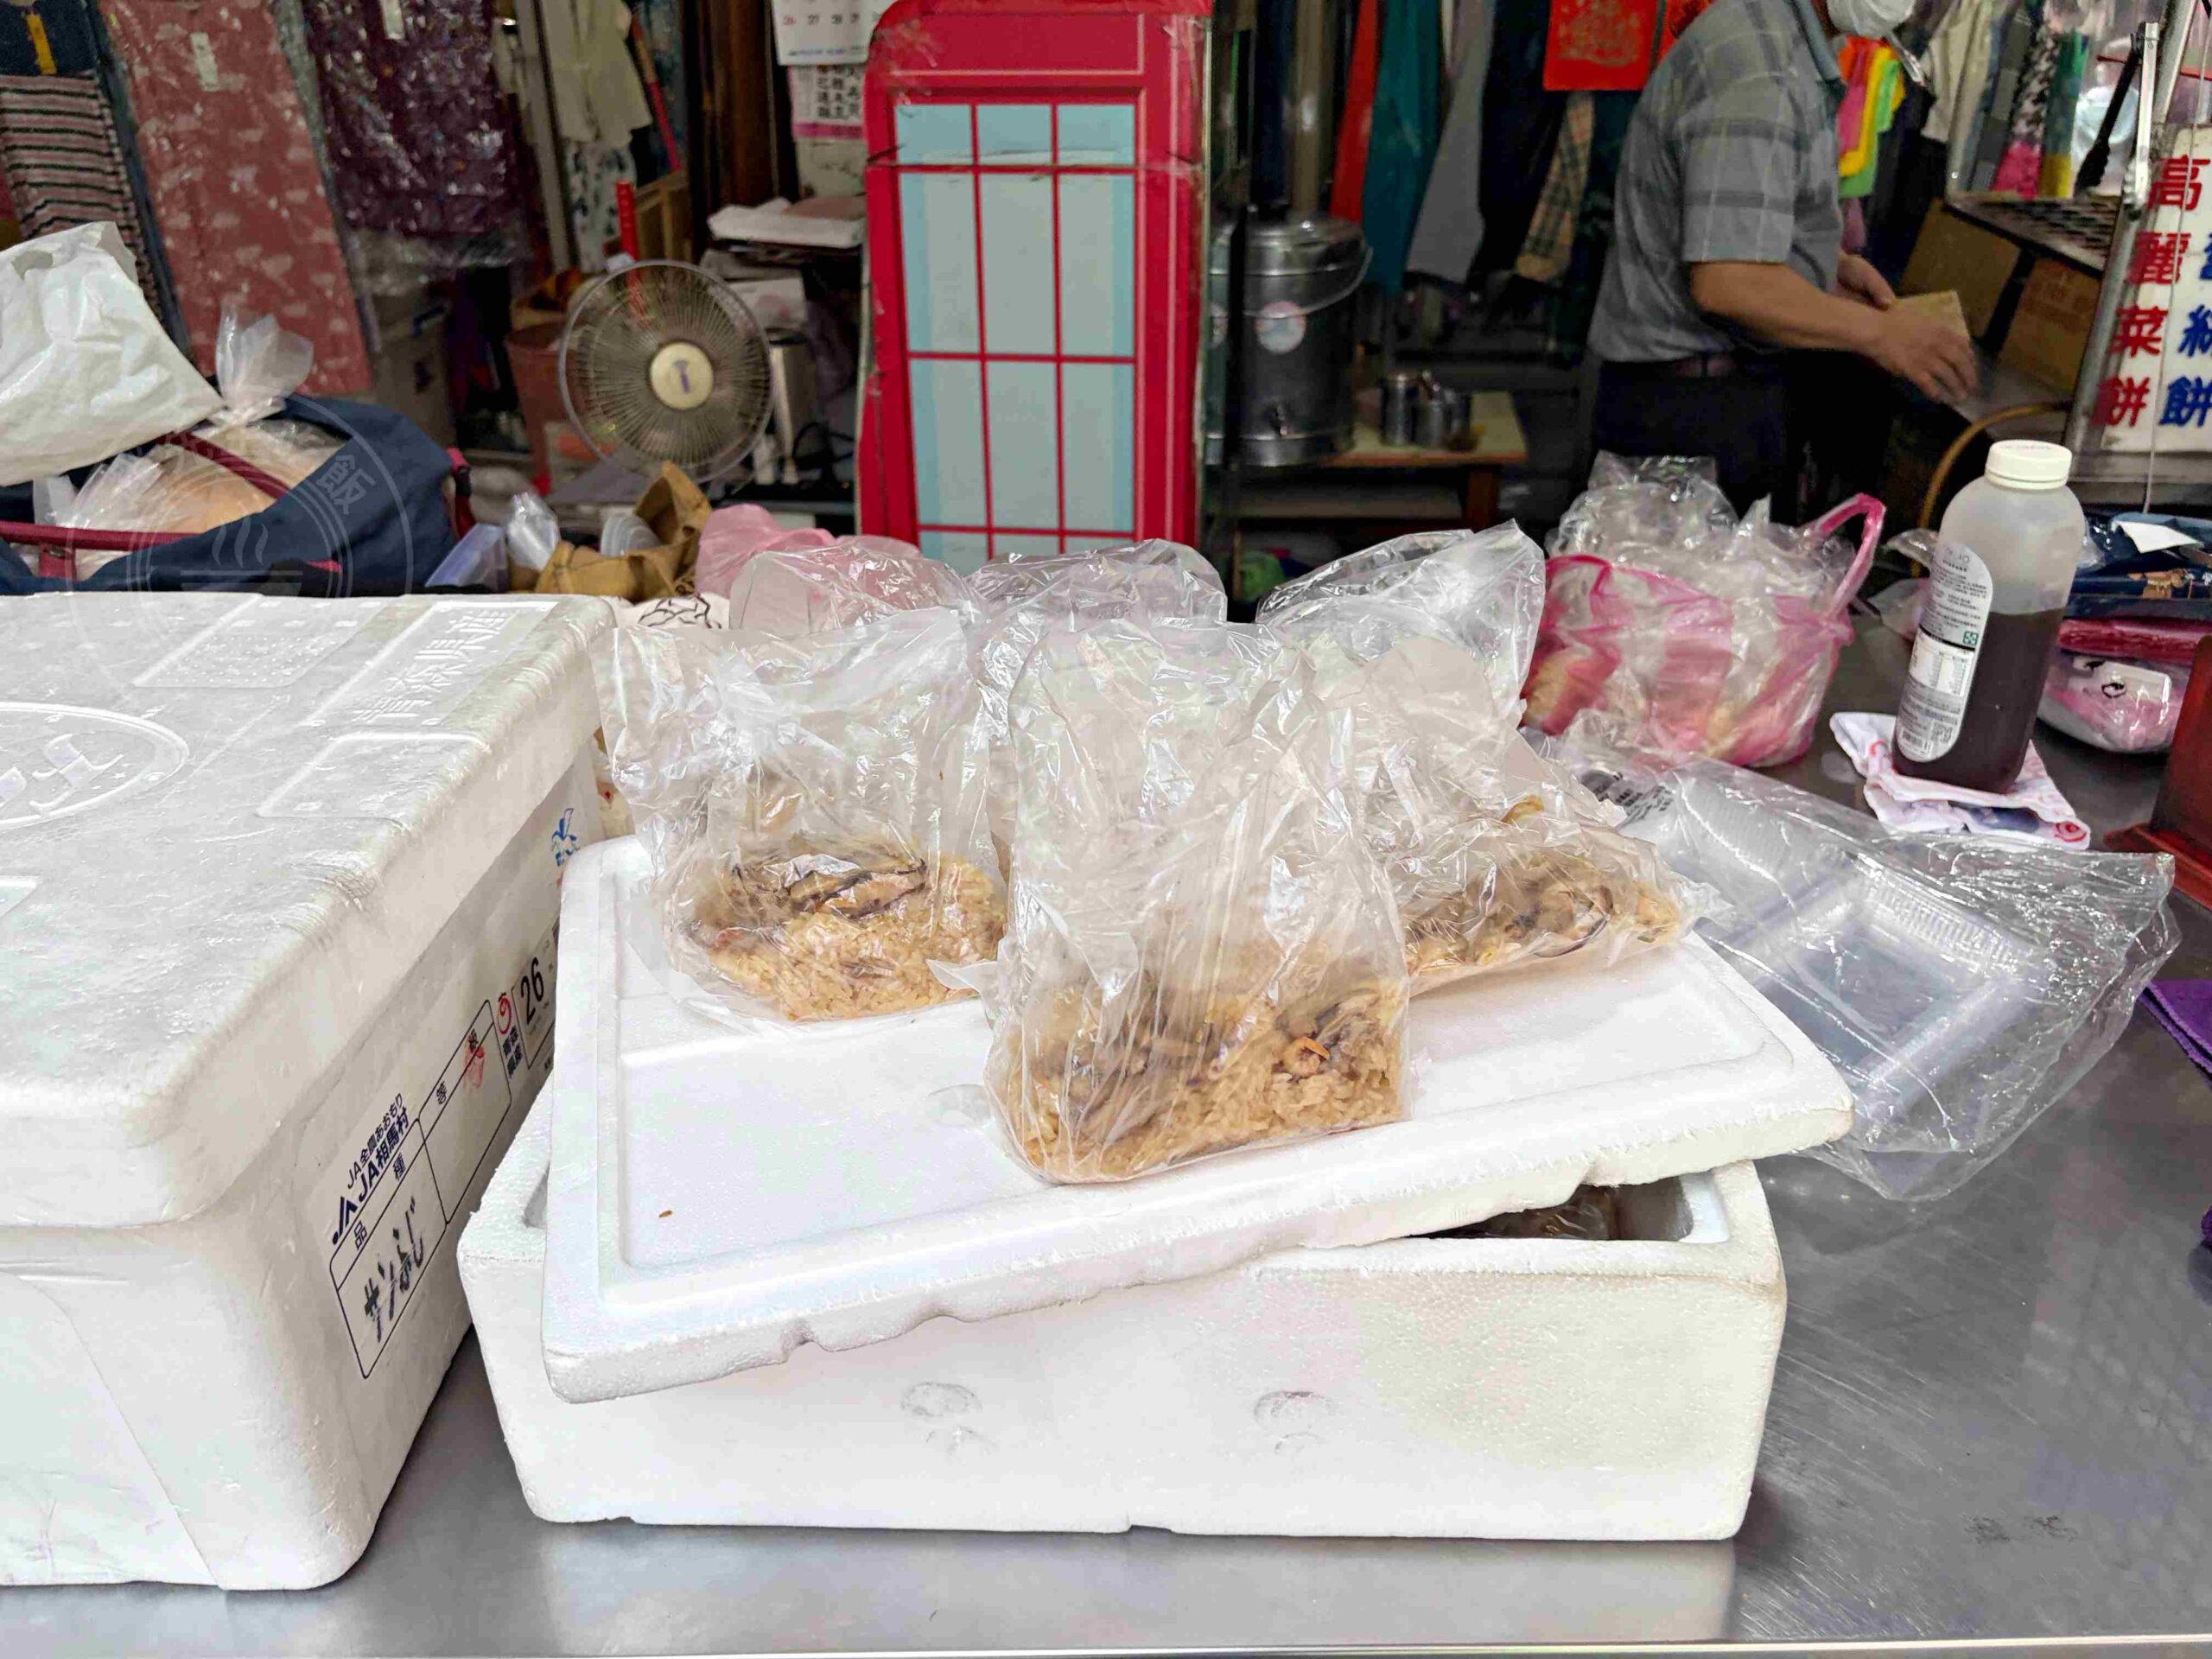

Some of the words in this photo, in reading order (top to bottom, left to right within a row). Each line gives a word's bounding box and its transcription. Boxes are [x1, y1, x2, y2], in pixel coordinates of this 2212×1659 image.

[2091, 154, 2210, 427] 高麗菜餅
[520, 957, 544, 1026] 26
[359, 1105, 410, 1203] JA相馬村
